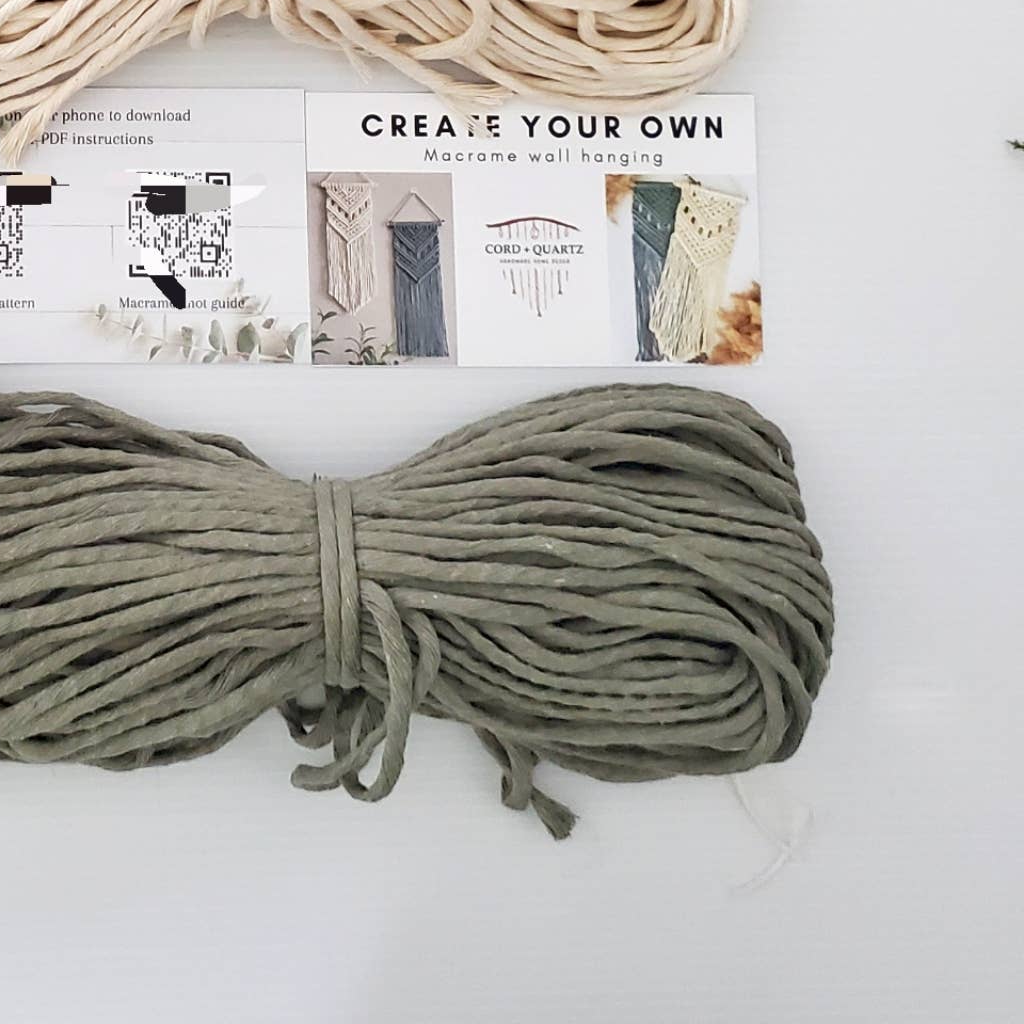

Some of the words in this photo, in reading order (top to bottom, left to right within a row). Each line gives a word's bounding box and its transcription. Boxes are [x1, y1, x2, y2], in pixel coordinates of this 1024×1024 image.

[62, 108, 104, 125] phone
[109, 109, 122, 122] to
[126, 108, 191, 122] download
[521, 115, 621, 139] YOUR
[640, 115, 723, 139] OWN
[41, 132, 68, 145] PDF
[72, 132, 154, 145] instructions
[424, 148, 517, 163] Macrame
[529, 148, 570, 163] wall
[581, 148, 663, 167] hanging
[484, 244, 521, 254] CORD
[532, 244, 584, 256] QUARTZ
[211, 297, 245, 311] guide
